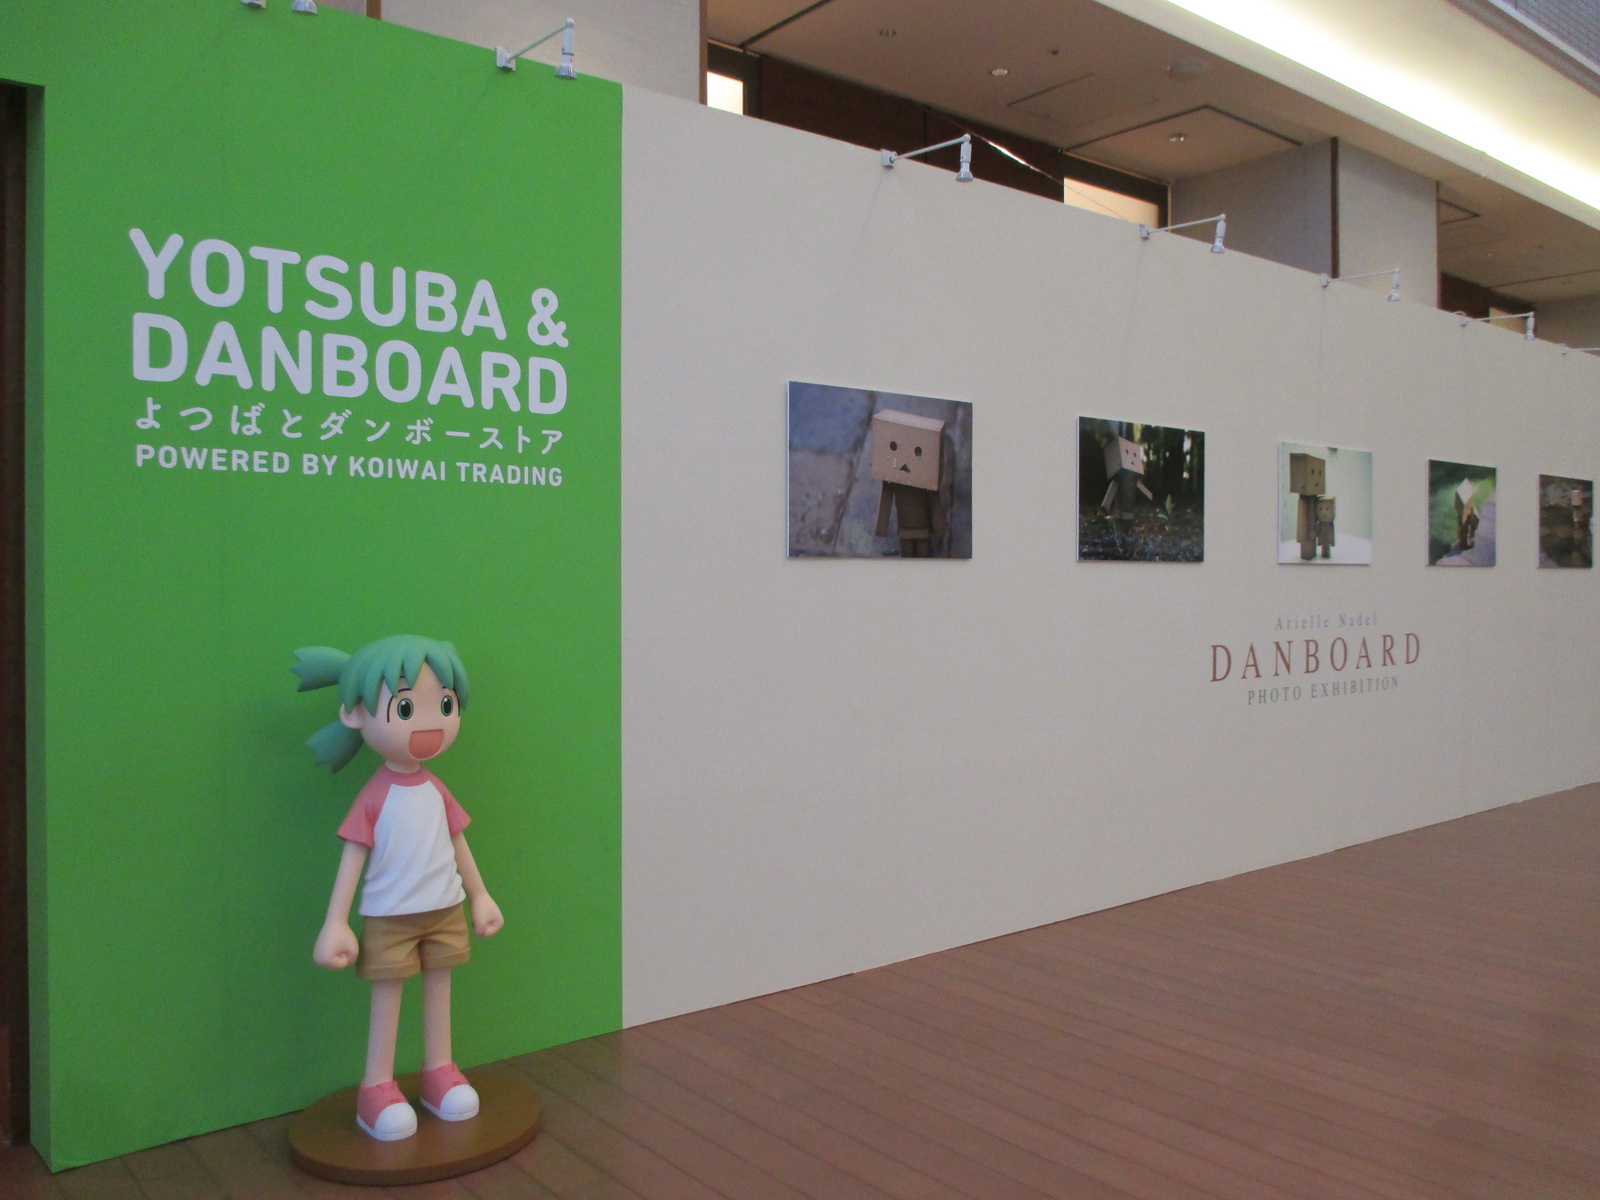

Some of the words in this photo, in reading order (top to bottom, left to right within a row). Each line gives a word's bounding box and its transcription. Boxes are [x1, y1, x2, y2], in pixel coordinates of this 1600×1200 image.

[128, 227, 507, 341] YOTSUBA
[526, 287, 570, 348] &
[132, 311, 568, 415] DANBOARD
[135, 396, 564, 455] よつばとダンボーストア
[135, 444, 290, 474] POWERED
[302, 453, 338, 476] BY
[349, 455, 447, 481] KOIWAI
[456, 461, 563, 487] TRADING
[1275, 614, 1330, 631] Arielle
[1338, 612, 1377, 628] Nadel
[1210, 632, 1420, 682] DANBOARD
[1247, 685, 1302, 706] PHOTO
[1311, 675, 1399, 699] EXHIBITION
